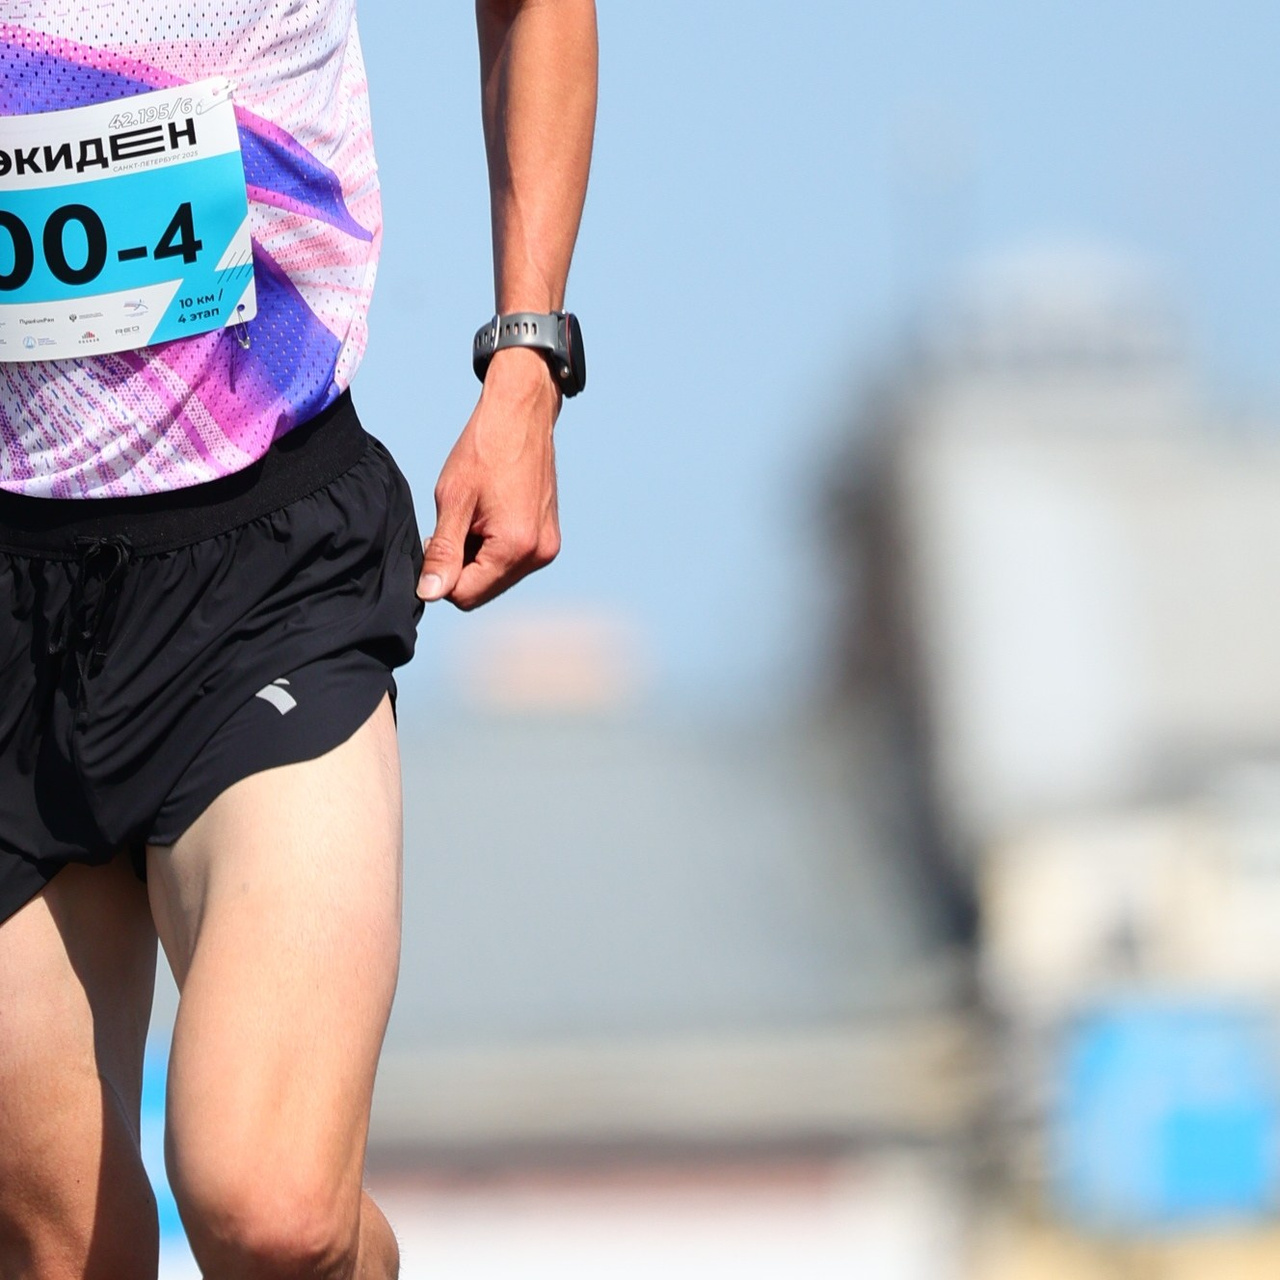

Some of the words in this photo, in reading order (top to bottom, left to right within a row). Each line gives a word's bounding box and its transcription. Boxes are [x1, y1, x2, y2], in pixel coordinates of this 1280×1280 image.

[108, 97, 193, 130] 42.195/6
[112, 153, 181, 173] САНКТ-ПЕТЕРБУРГ
[182, 150, 199, 160] 2025
[179, 297, 193, 310] 10
[196, 294, 215, 306] км
[177, 314, 186, 324] 4
[189, 307, 220, 322] этап
